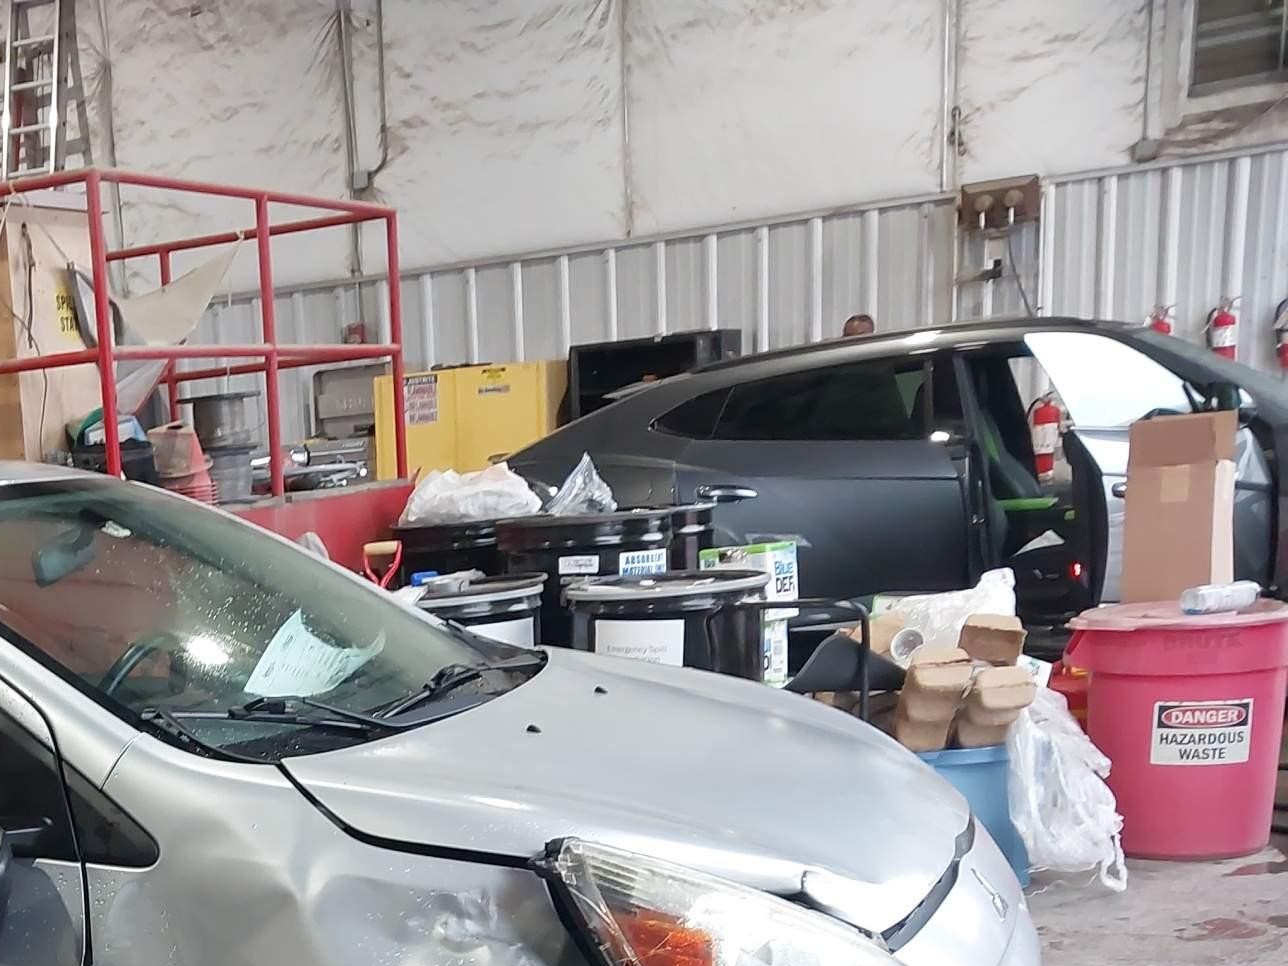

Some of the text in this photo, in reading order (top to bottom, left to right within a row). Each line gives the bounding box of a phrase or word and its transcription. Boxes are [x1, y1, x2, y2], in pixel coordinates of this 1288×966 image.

[1170, 709, 1239, 725] DANGER
[1159, 730, 1245, 745] HAZARDOUS
[1178, 747, 1227, 760] WASTE
